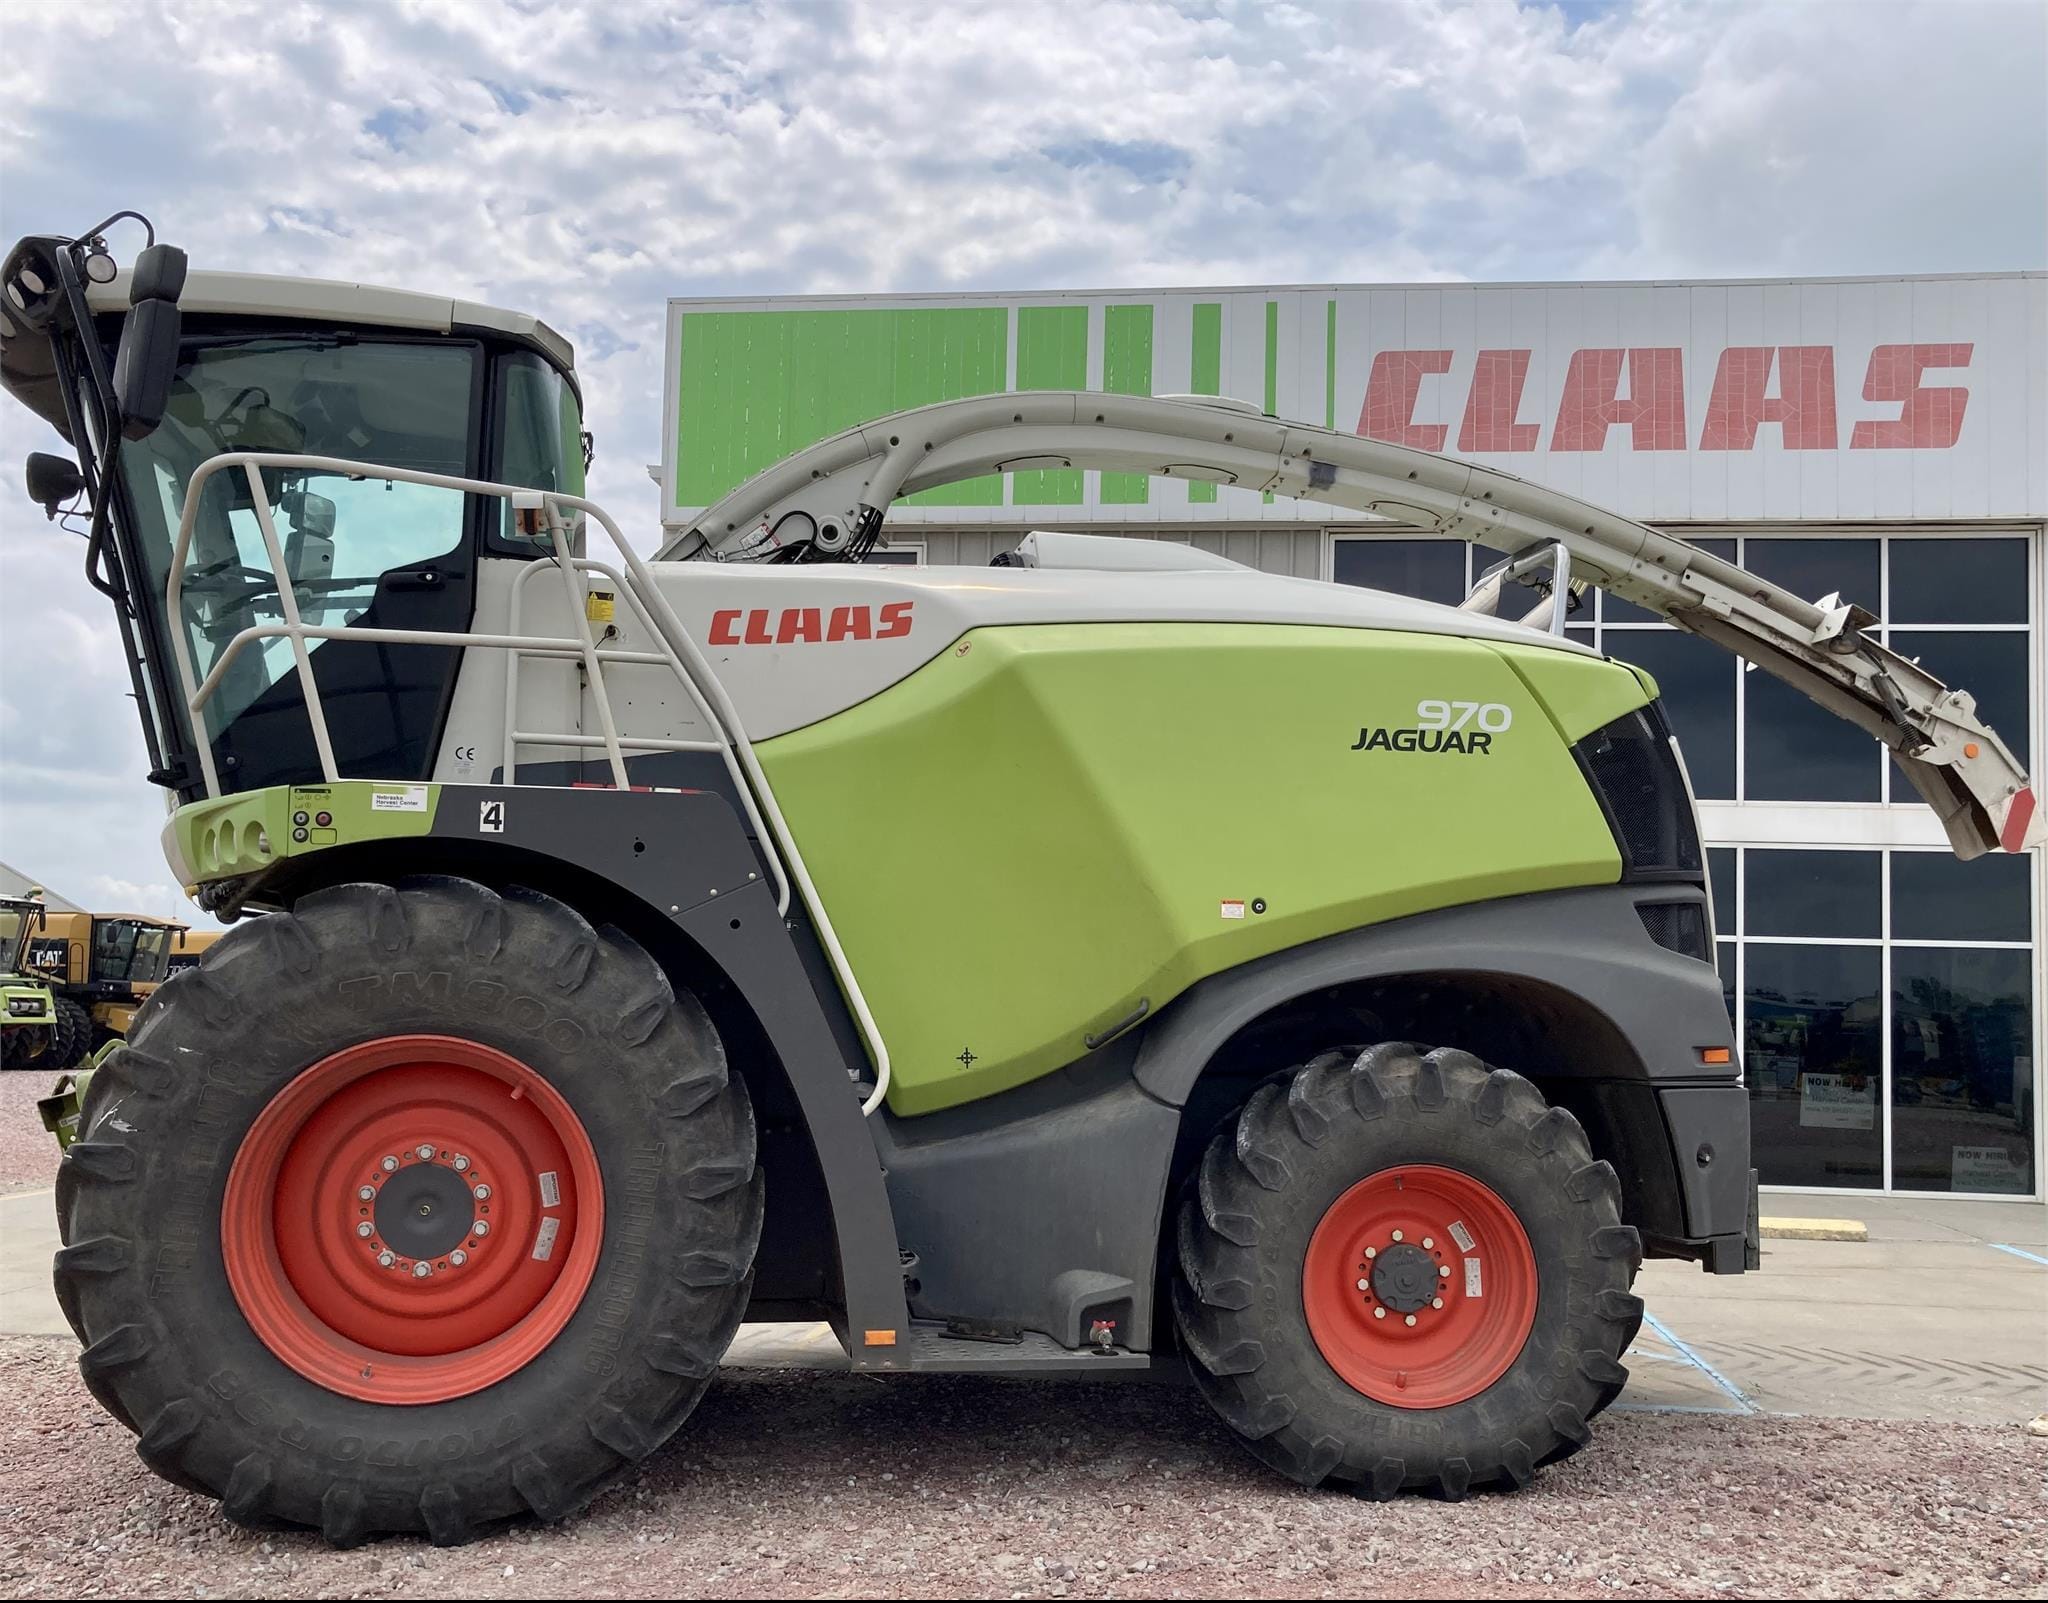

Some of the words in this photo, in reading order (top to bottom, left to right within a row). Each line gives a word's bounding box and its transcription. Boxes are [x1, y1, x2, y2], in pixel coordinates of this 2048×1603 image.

[1356, 343, 1974, 452] CLAAS
[708, 601, 914, 645] CLAAS
[1417, 700, 1512, 733] 970
[1351, 728, 1492, 755] JAGUAR
[483, 803, 503, 831] 4
[1807, 1077, 1831, 1087] NOW
[1957, 1150, 1982, 1160] NOW
